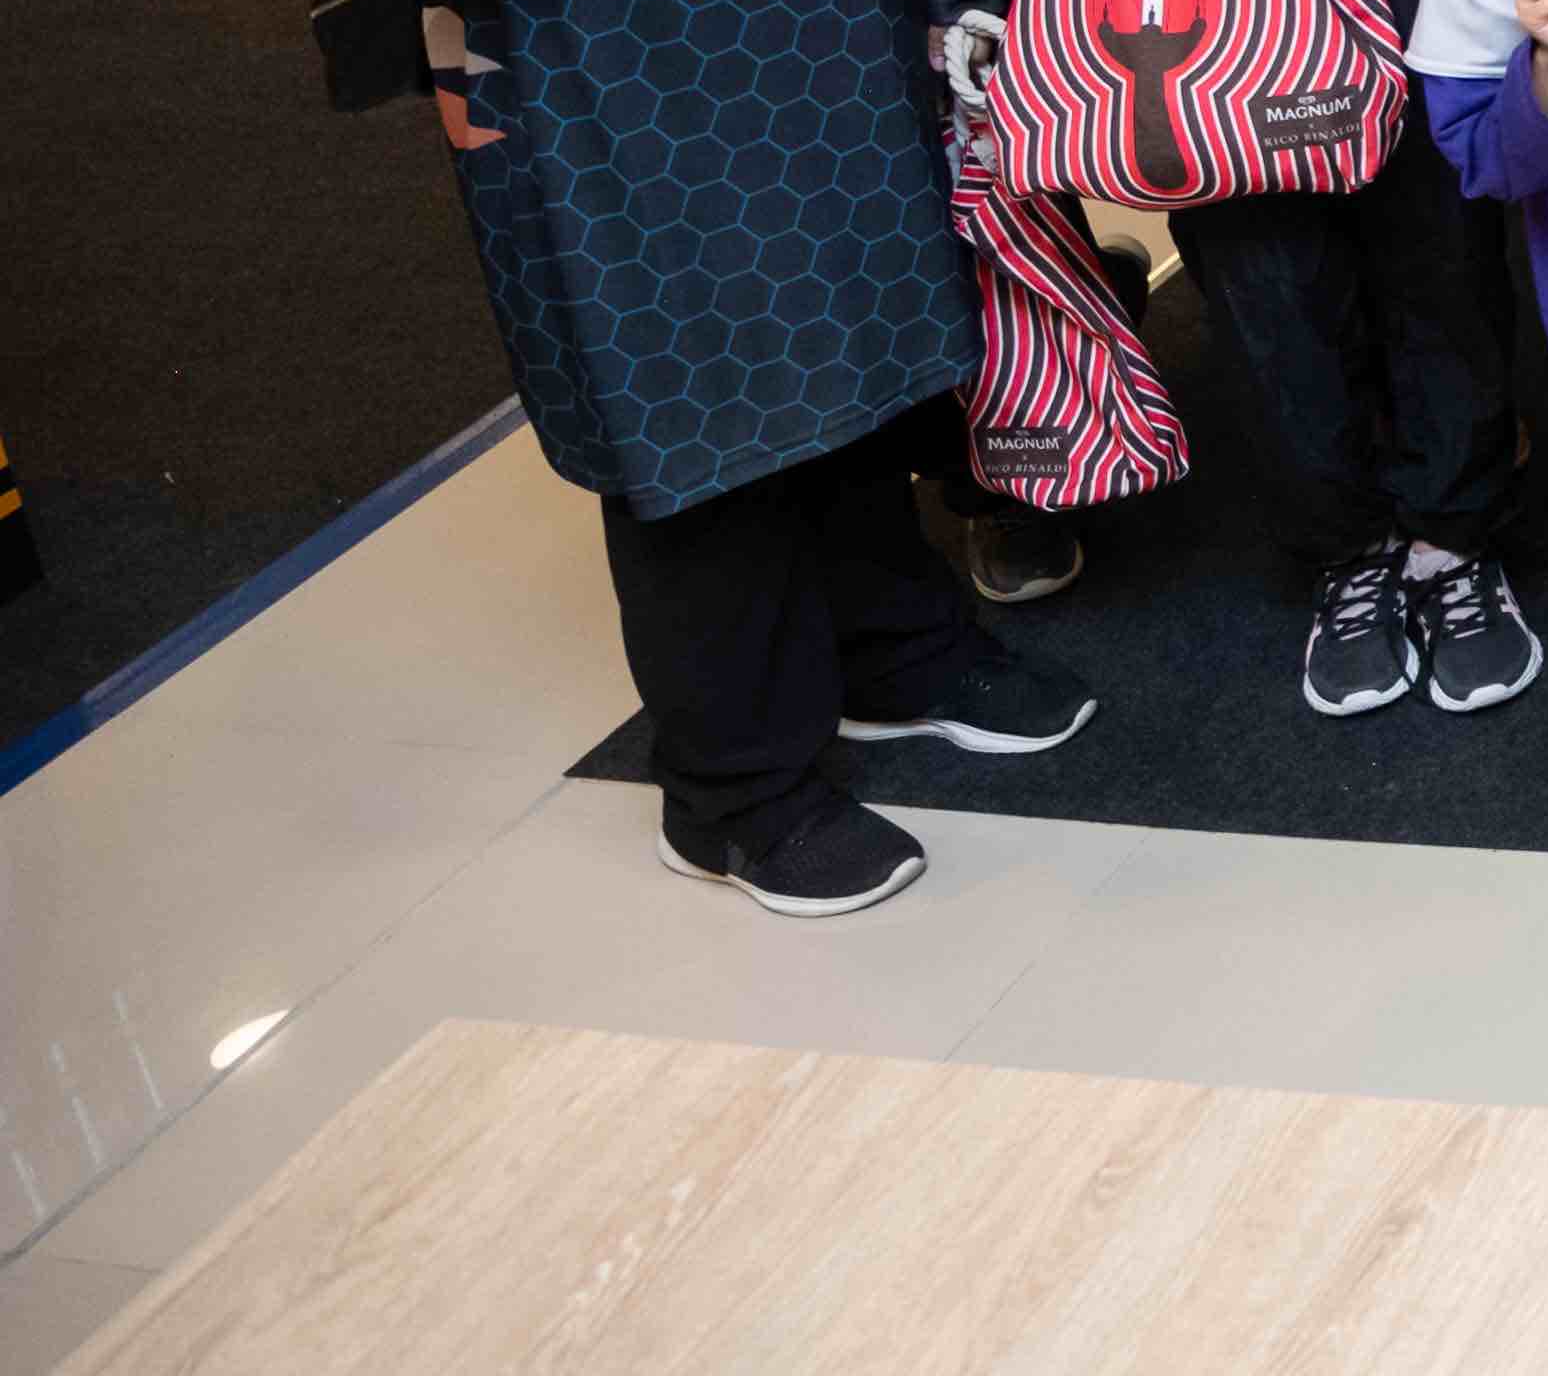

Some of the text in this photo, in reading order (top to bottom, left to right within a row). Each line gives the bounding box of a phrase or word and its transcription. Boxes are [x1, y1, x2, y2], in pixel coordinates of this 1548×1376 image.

[1265, 96, 1352, 123] MAGNUM
[1264, 123, 1361, 147] RICO RINALDI
[987, 437, 1060, 451] MAGNUM
